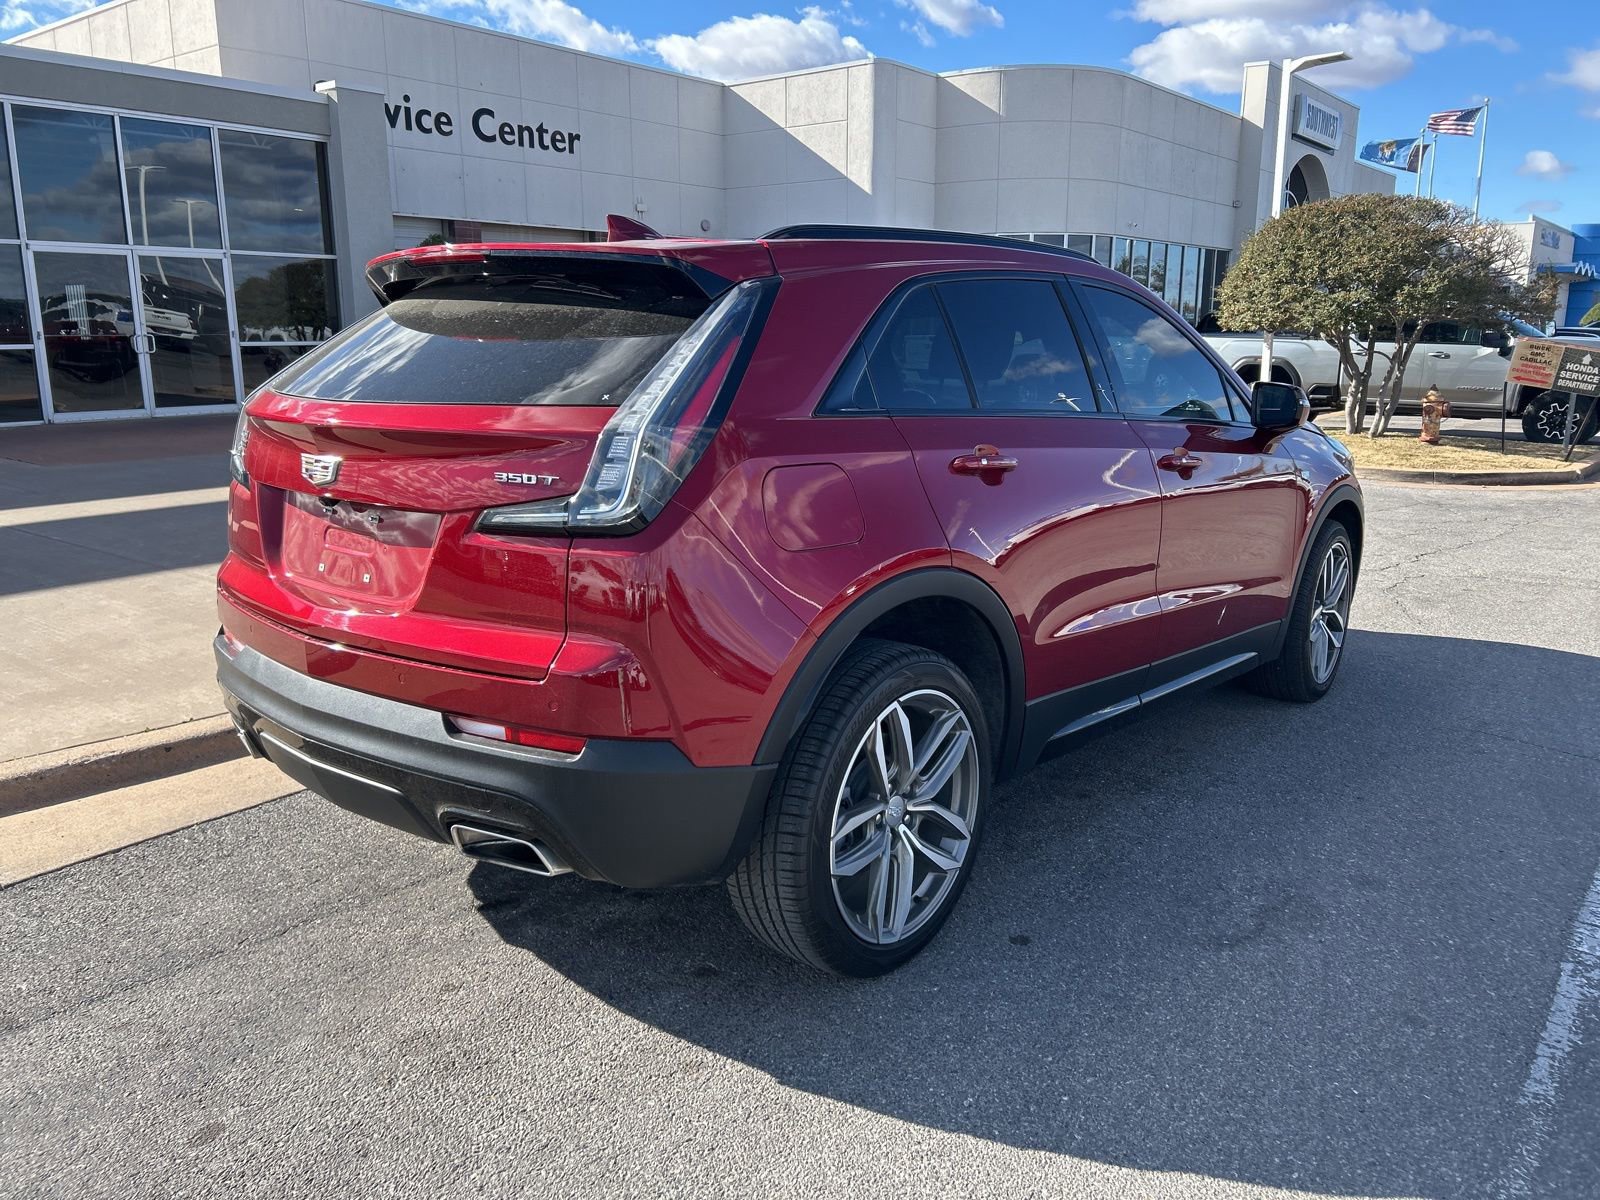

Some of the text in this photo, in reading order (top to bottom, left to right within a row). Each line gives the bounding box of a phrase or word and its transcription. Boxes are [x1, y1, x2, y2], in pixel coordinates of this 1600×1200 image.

[384, 94, 581, 155] vice Center
[1519, 356, 1552, 366] CADILLAC
[1566, 362, 1599, 375] HONDA
[1560, 370, 1600, 383] SERVICE
[1557, 378, 1597, 391] DEPARTMENT
